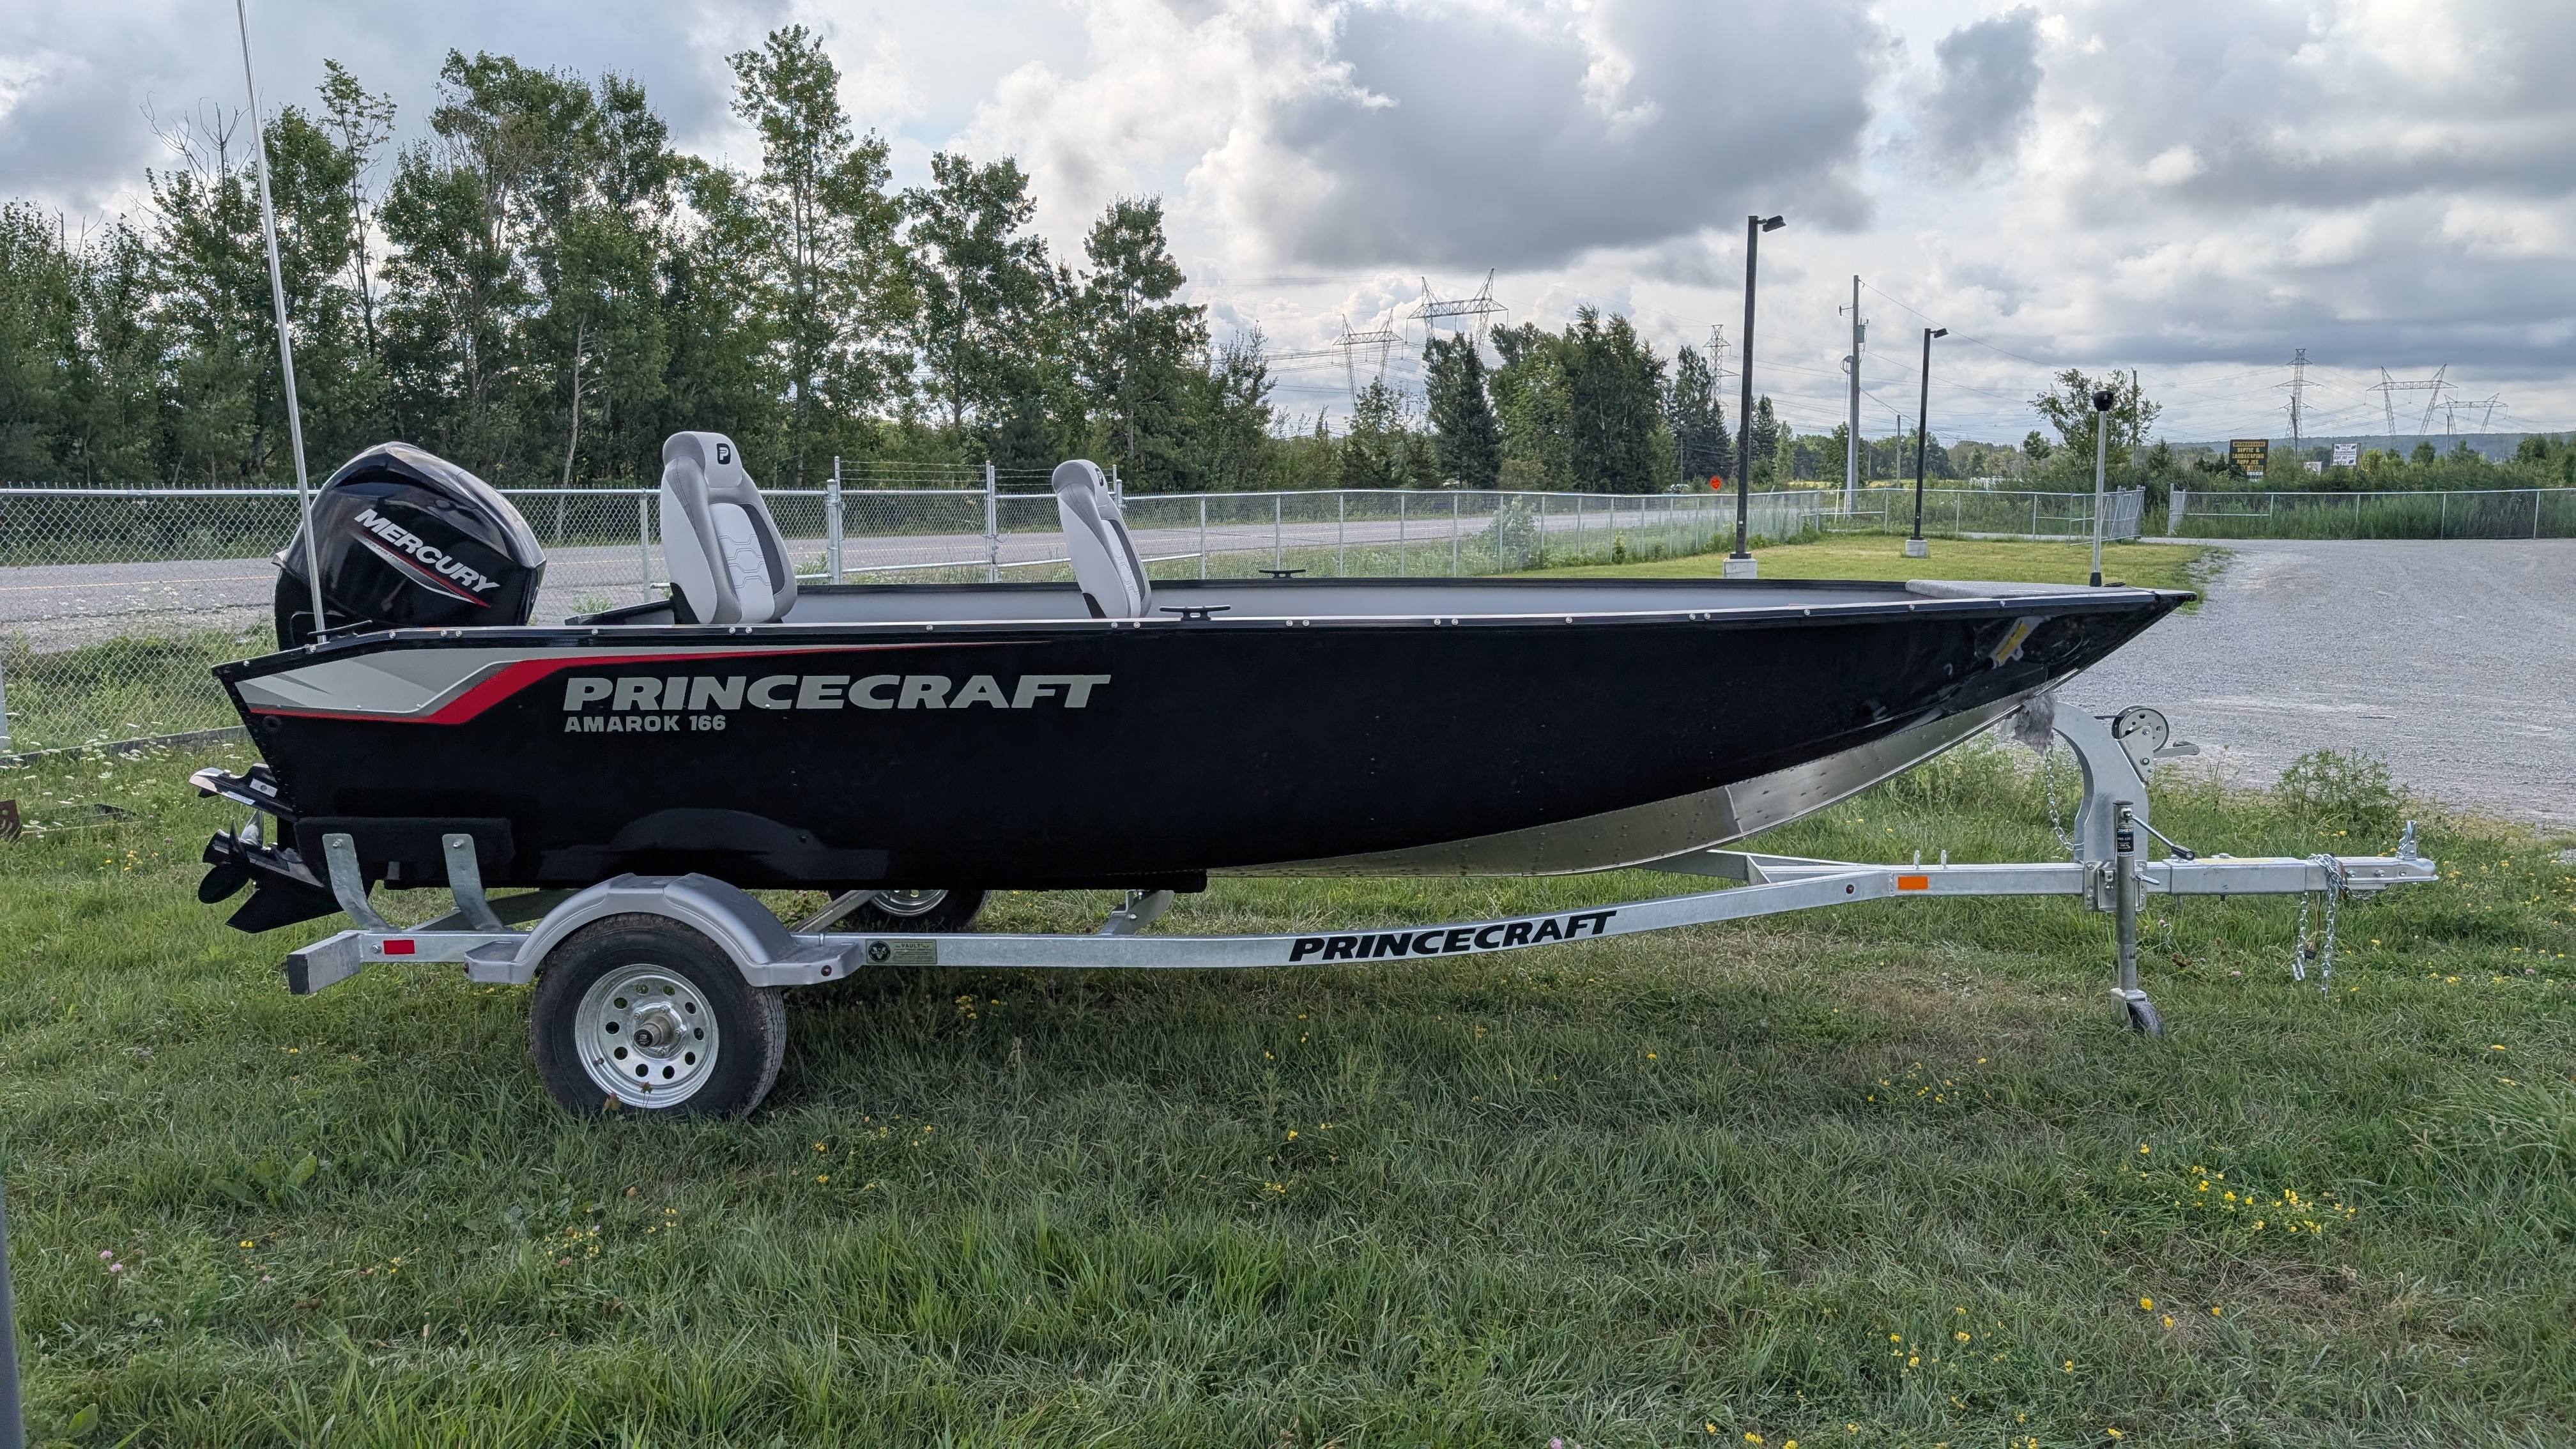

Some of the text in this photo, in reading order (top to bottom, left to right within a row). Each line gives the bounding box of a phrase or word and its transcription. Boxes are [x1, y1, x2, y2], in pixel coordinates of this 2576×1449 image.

[353, 508, 500, 593] MERCURY
[563, 674, 1111, 711] PRINCECRAFT
[564, 714, 726, 732] AMAROK 166
[1288, 910, 1617, 962] PRINCECRAFT
